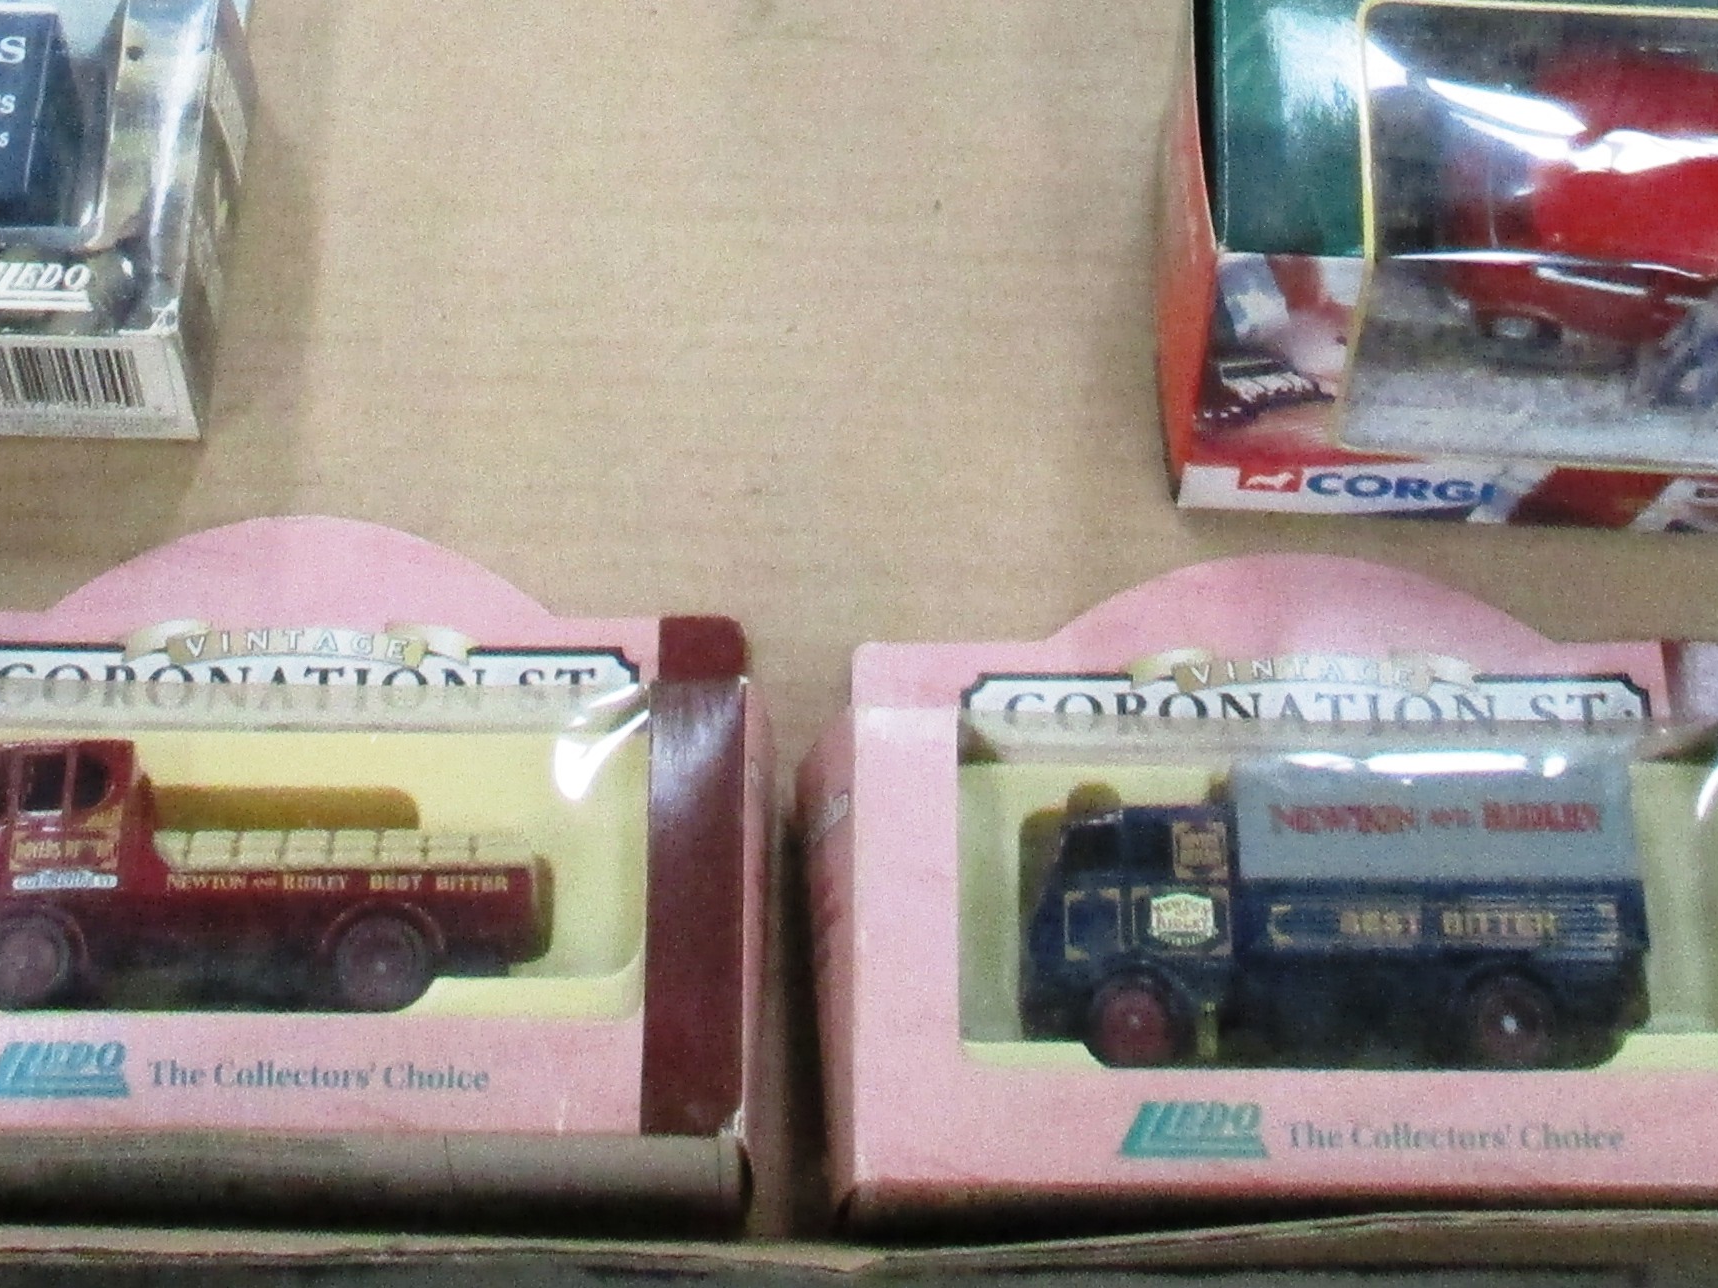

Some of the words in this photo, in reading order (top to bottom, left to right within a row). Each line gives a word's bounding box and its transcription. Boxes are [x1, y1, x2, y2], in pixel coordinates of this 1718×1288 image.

[1303, 470, 1496, 505] CORGI
[184, 627, 413, 661] VINTAGE
[1191, 656, 1412, 686] VINTAGE
[1003, 690, 1497, 732] CORONATION
[283, 873, 350, 892] RIDLEY
[369, 873, 424, 892] BEST
[147, 1059, 205, 1087] The
[213, 1060, 377, 1090] Collectors'
[383, 1064, 491, 1094] Choice
[1287, 1122, 1344, 1150] The
[1519, 1124, 1626, 1153] Choice
